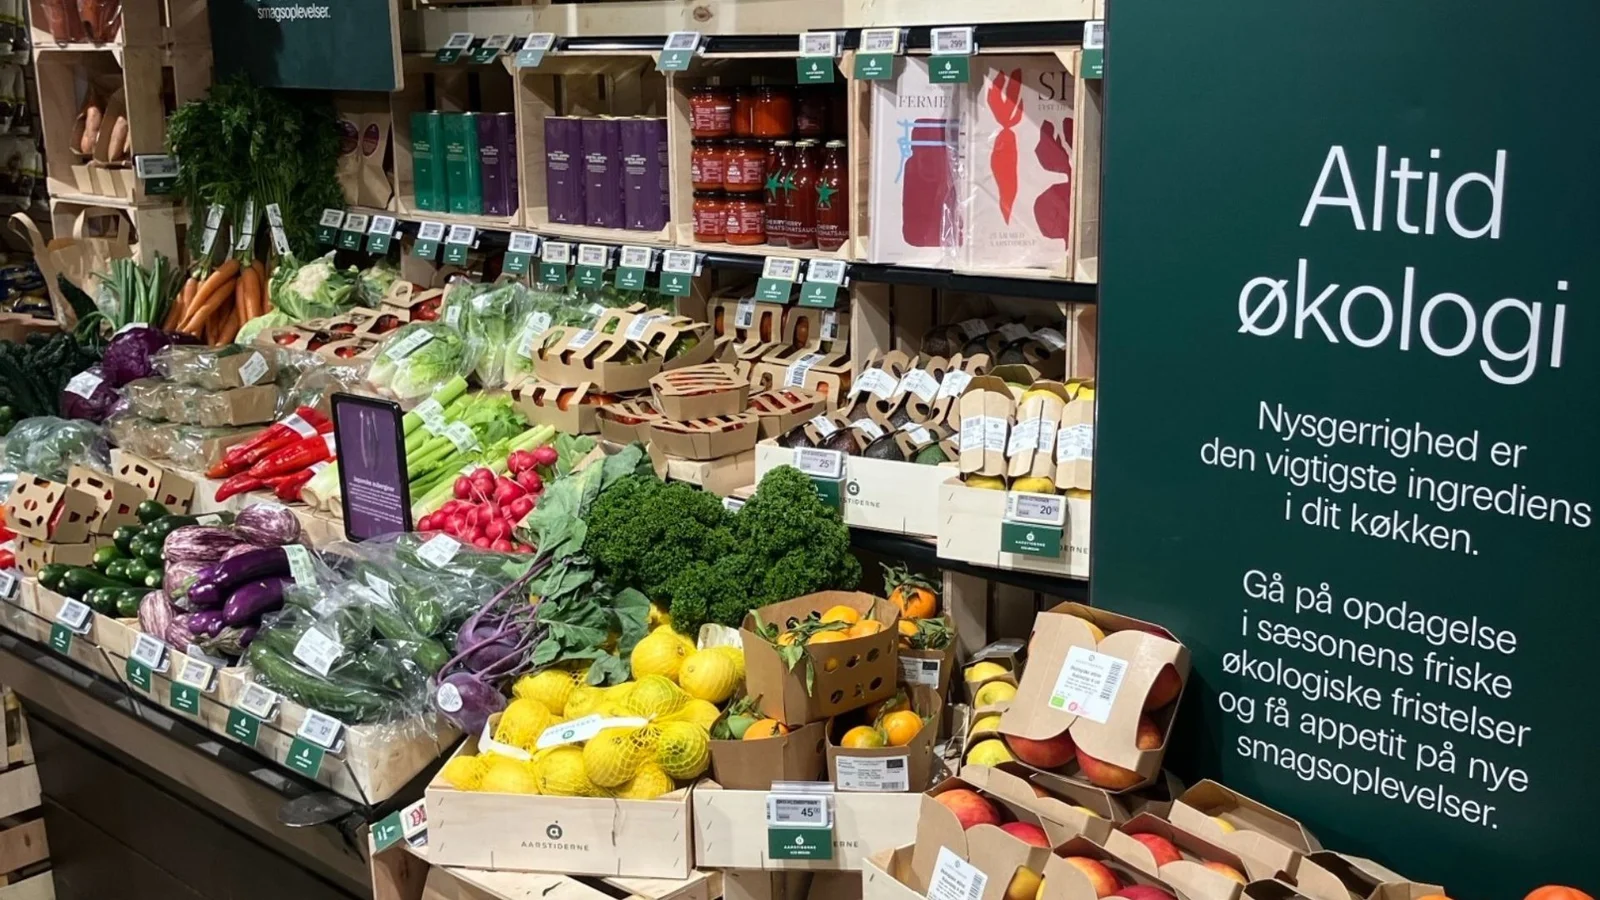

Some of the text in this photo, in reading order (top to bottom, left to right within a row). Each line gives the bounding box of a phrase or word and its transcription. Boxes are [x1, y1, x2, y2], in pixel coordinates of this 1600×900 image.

[257, 3, 331, 22] smagsoplevelser.
[1300, 145, 1506, 239] Altid
[1238, 258, 1568, 384] økologi
[1259, 401, 1527, 468] Nysgerrighed er
[1201, 437, 1591, 527] den vigtigste ingrediens
[1286, 492, 1478, 555] i dit køkken.
[1243, 609, 1512, 698] i sæsonens friske
[1244, 570, 1516, 654] Gå på opdagelse
[1219, 692, 1528, 792] og få appetit på nye
[1223, 649, 1531, 747] økologiske fristelser
[1237, 736, 1497, 829] smagsoplevelser.
[521, 841, 589, 851] AARSTIDERNE
